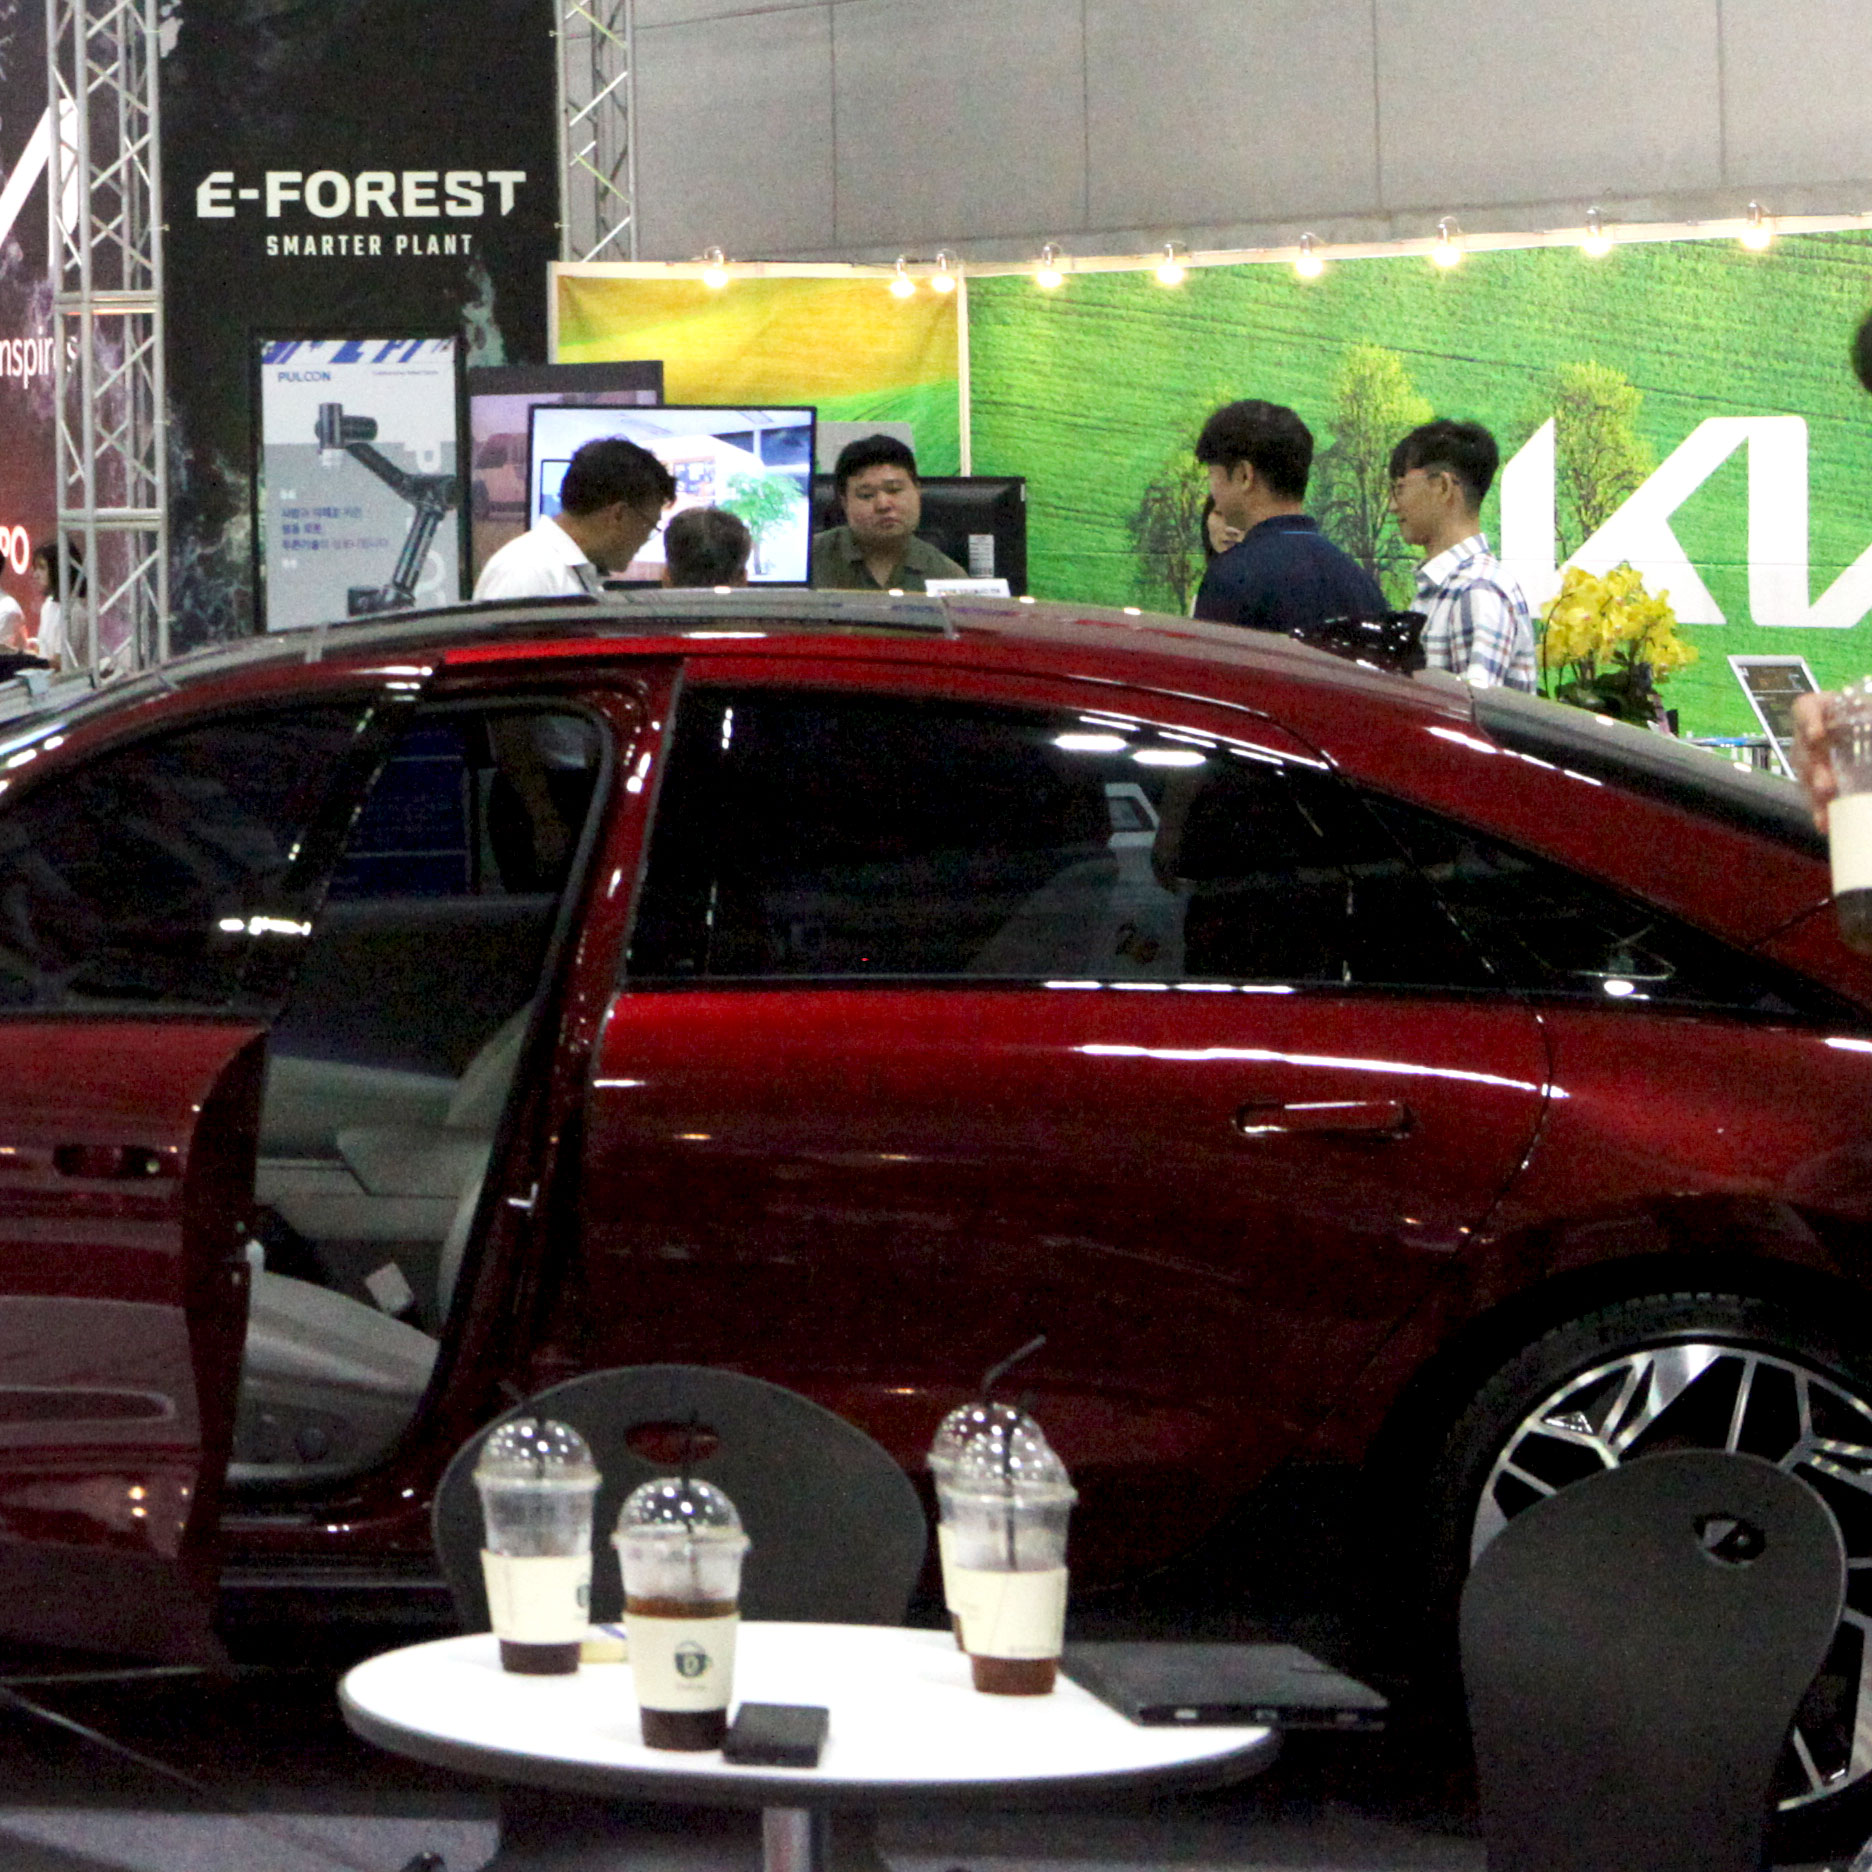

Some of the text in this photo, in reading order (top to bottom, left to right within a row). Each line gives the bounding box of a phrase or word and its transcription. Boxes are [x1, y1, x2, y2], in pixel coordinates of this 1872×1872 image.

[197, 170, 527, 218] E-FOREST
[266, 234, 473, 256] SMARTER PLANT
[277, 371, 331, 382] PULOON
[1500, 415, 1872, 629] KI
